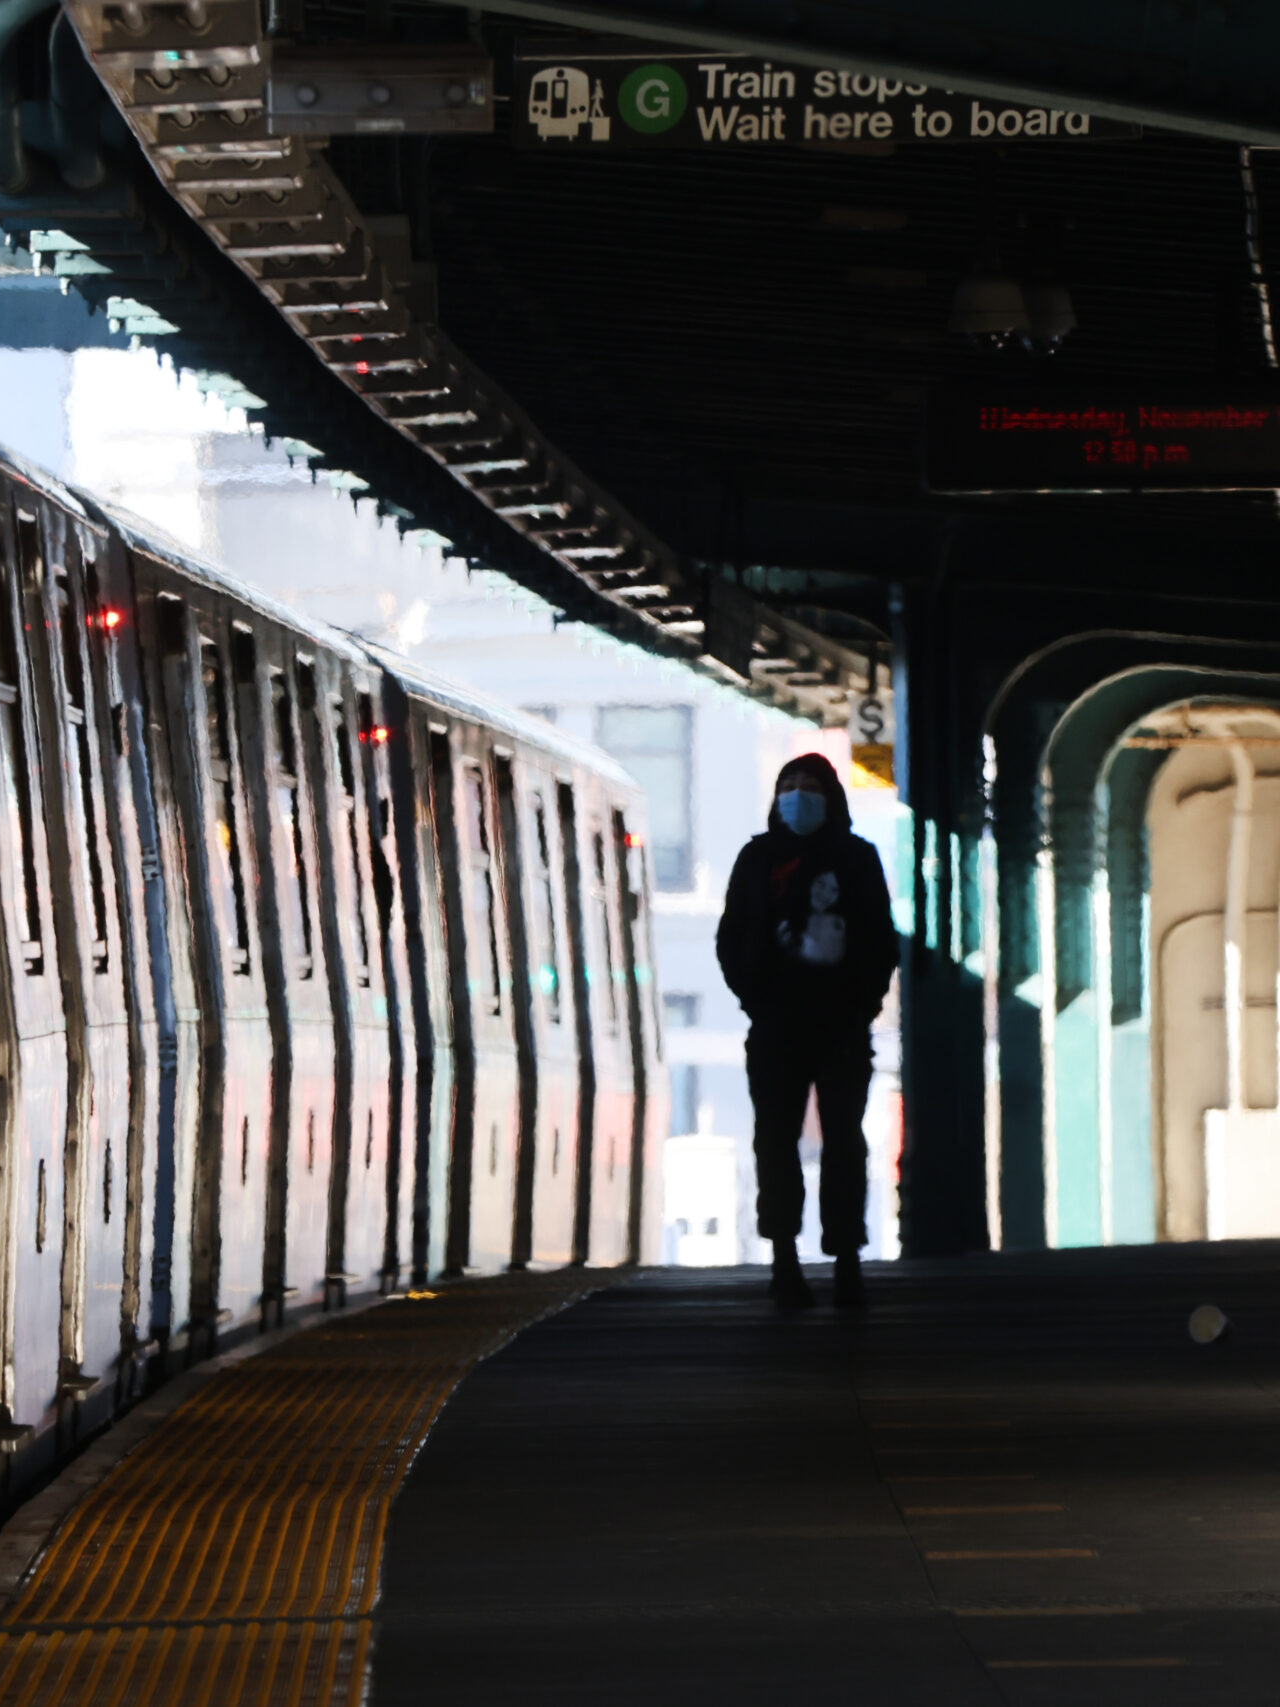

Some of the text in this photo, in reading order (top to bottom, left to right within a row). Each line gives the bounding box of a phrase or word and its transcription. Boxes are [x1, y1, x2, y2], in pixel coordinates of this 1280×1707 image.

[635, 79, 670, 118] G
[698, 63, 795, 99] Train
[696, 105, 786, 142] Wait
[803, 104, 894, 139] here
[912, 104, 953, 137] to
[1139, 405, 1269, 431] November
[857, 698, 884, 733] S
